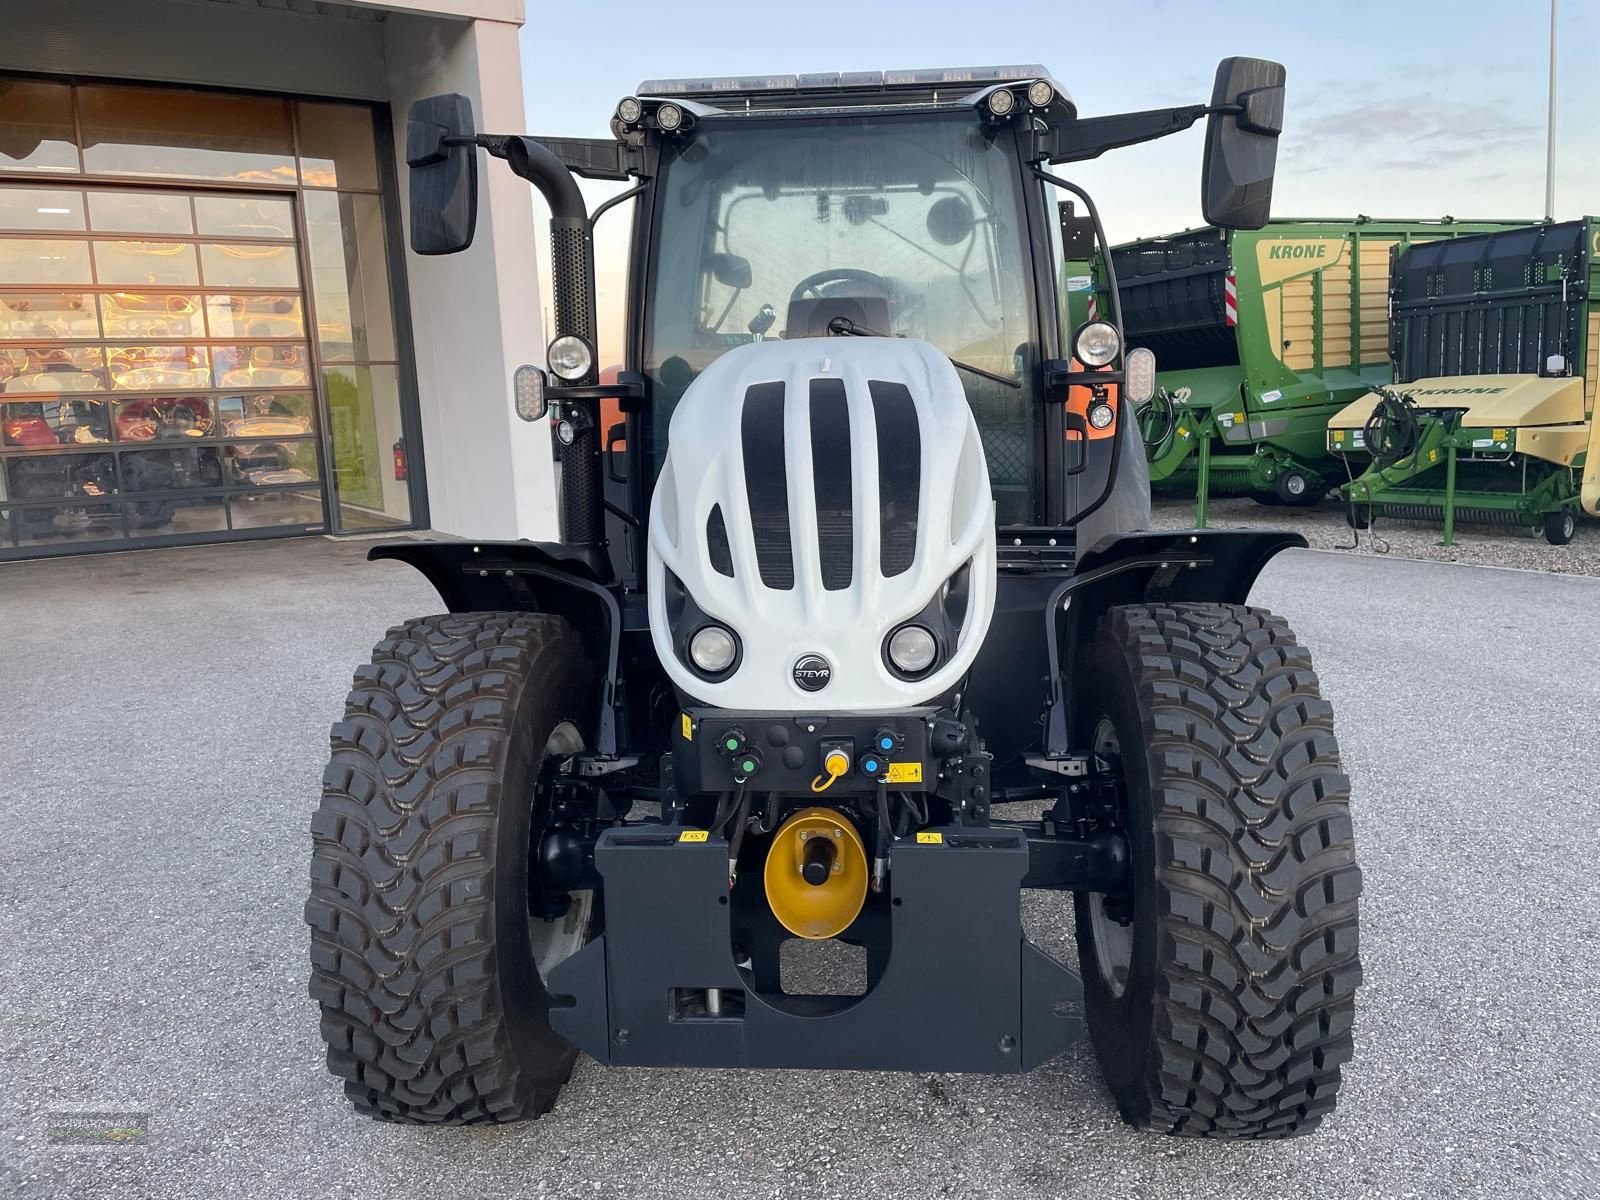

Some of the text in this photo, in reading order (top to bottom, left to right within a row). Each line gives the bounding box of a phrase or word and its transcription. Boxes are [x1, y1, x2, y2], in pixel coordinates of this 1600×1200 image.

[1269, 244, 1326, 259] KRONE
[1420, 387, 1507, 395] KRONE
[794, 669, 829, 678] STEYR
